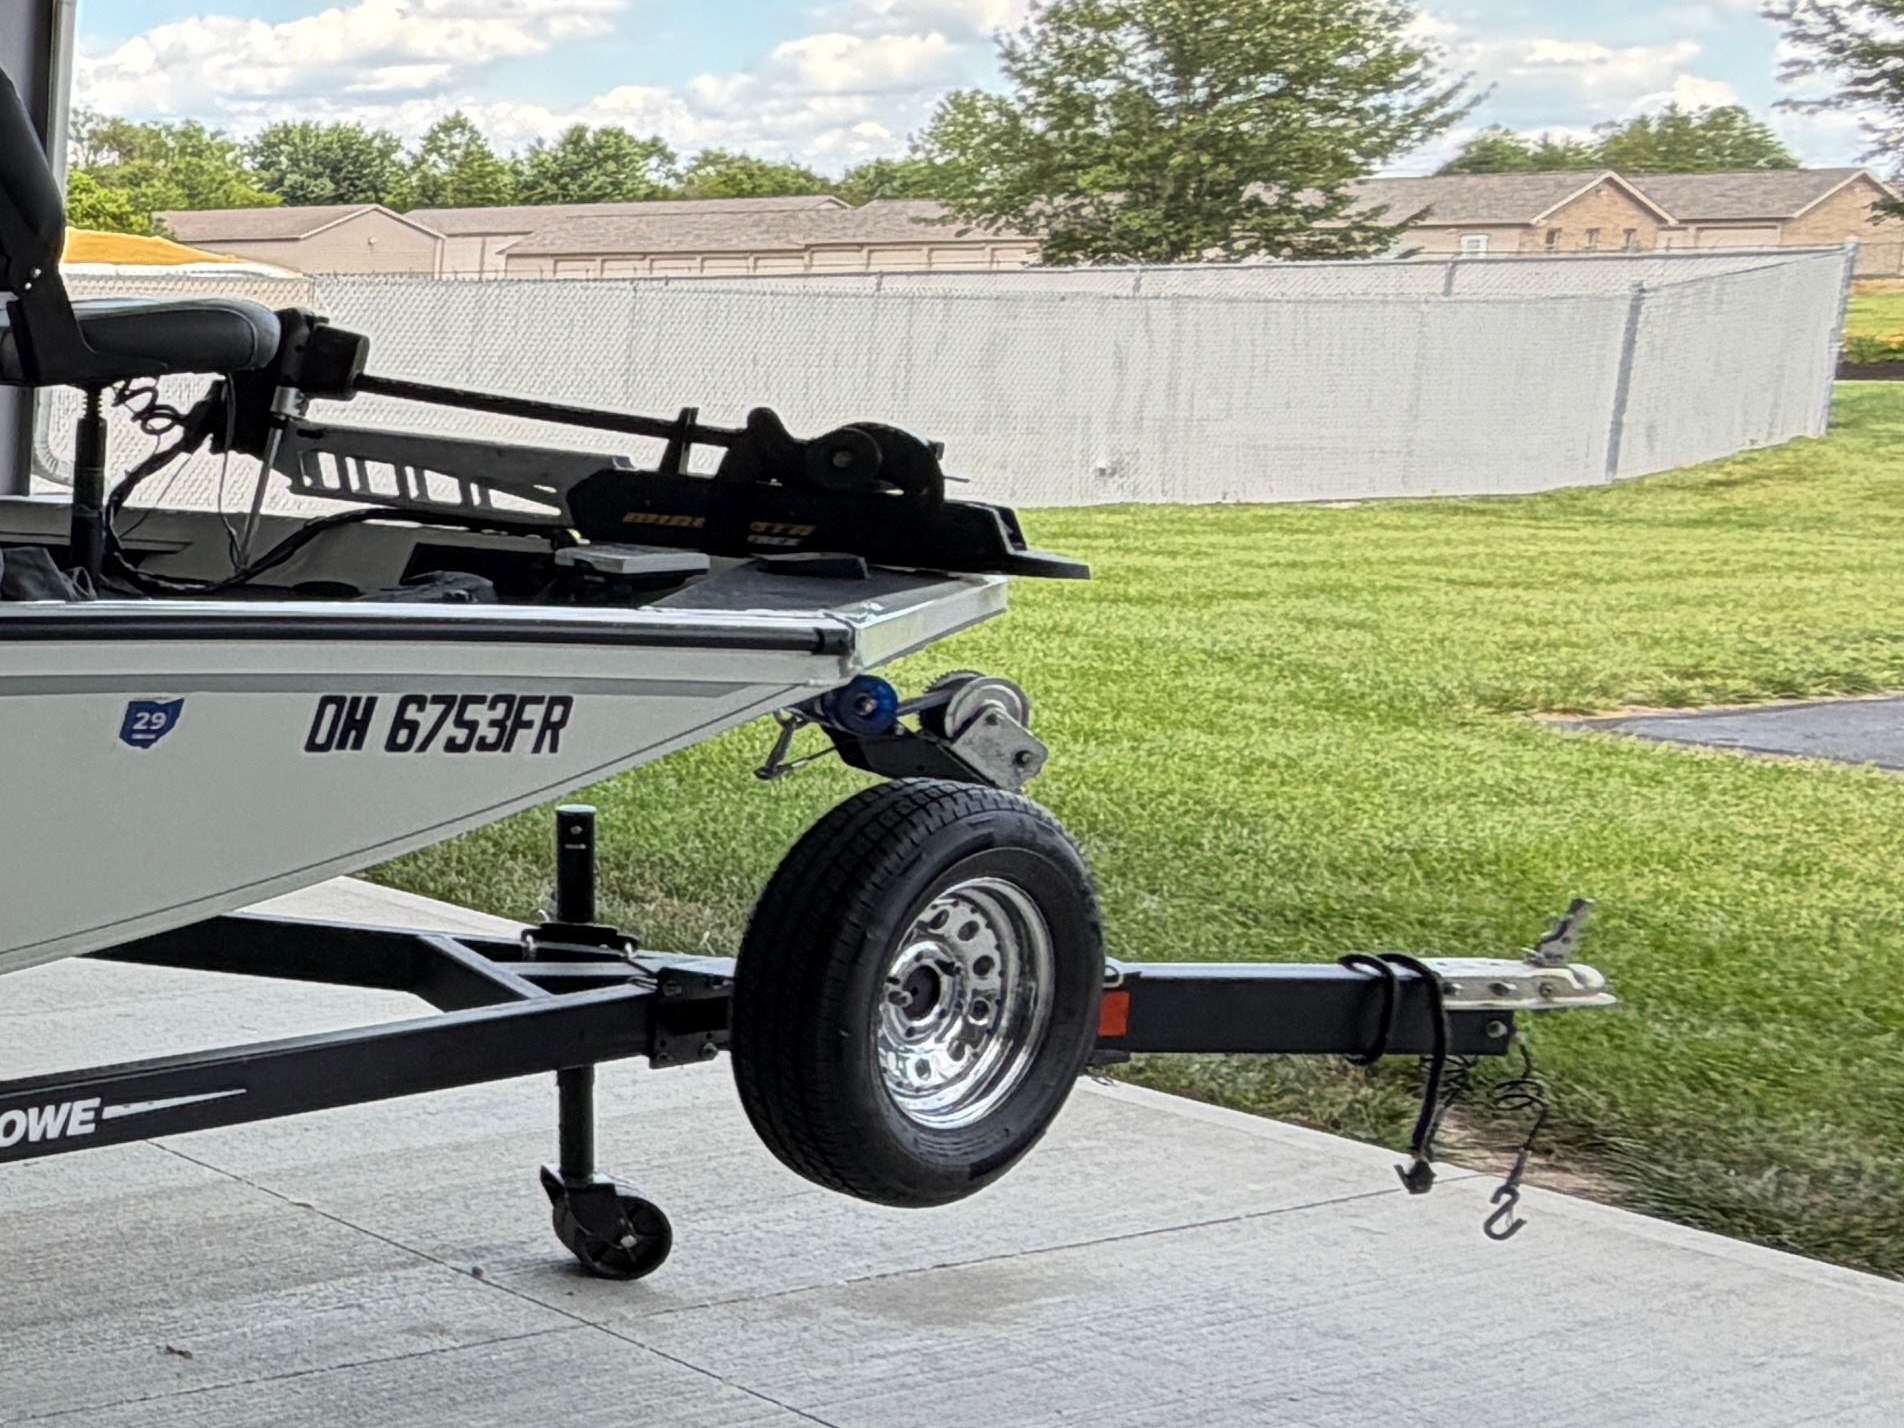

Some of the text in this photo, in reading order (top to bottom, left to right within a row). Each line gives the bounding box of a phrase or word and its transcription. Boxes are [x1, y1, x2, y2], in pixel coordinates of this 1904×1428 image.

[132, 711, 167, 731] 29
[303, 693, 574, 754] OH 6753FR
